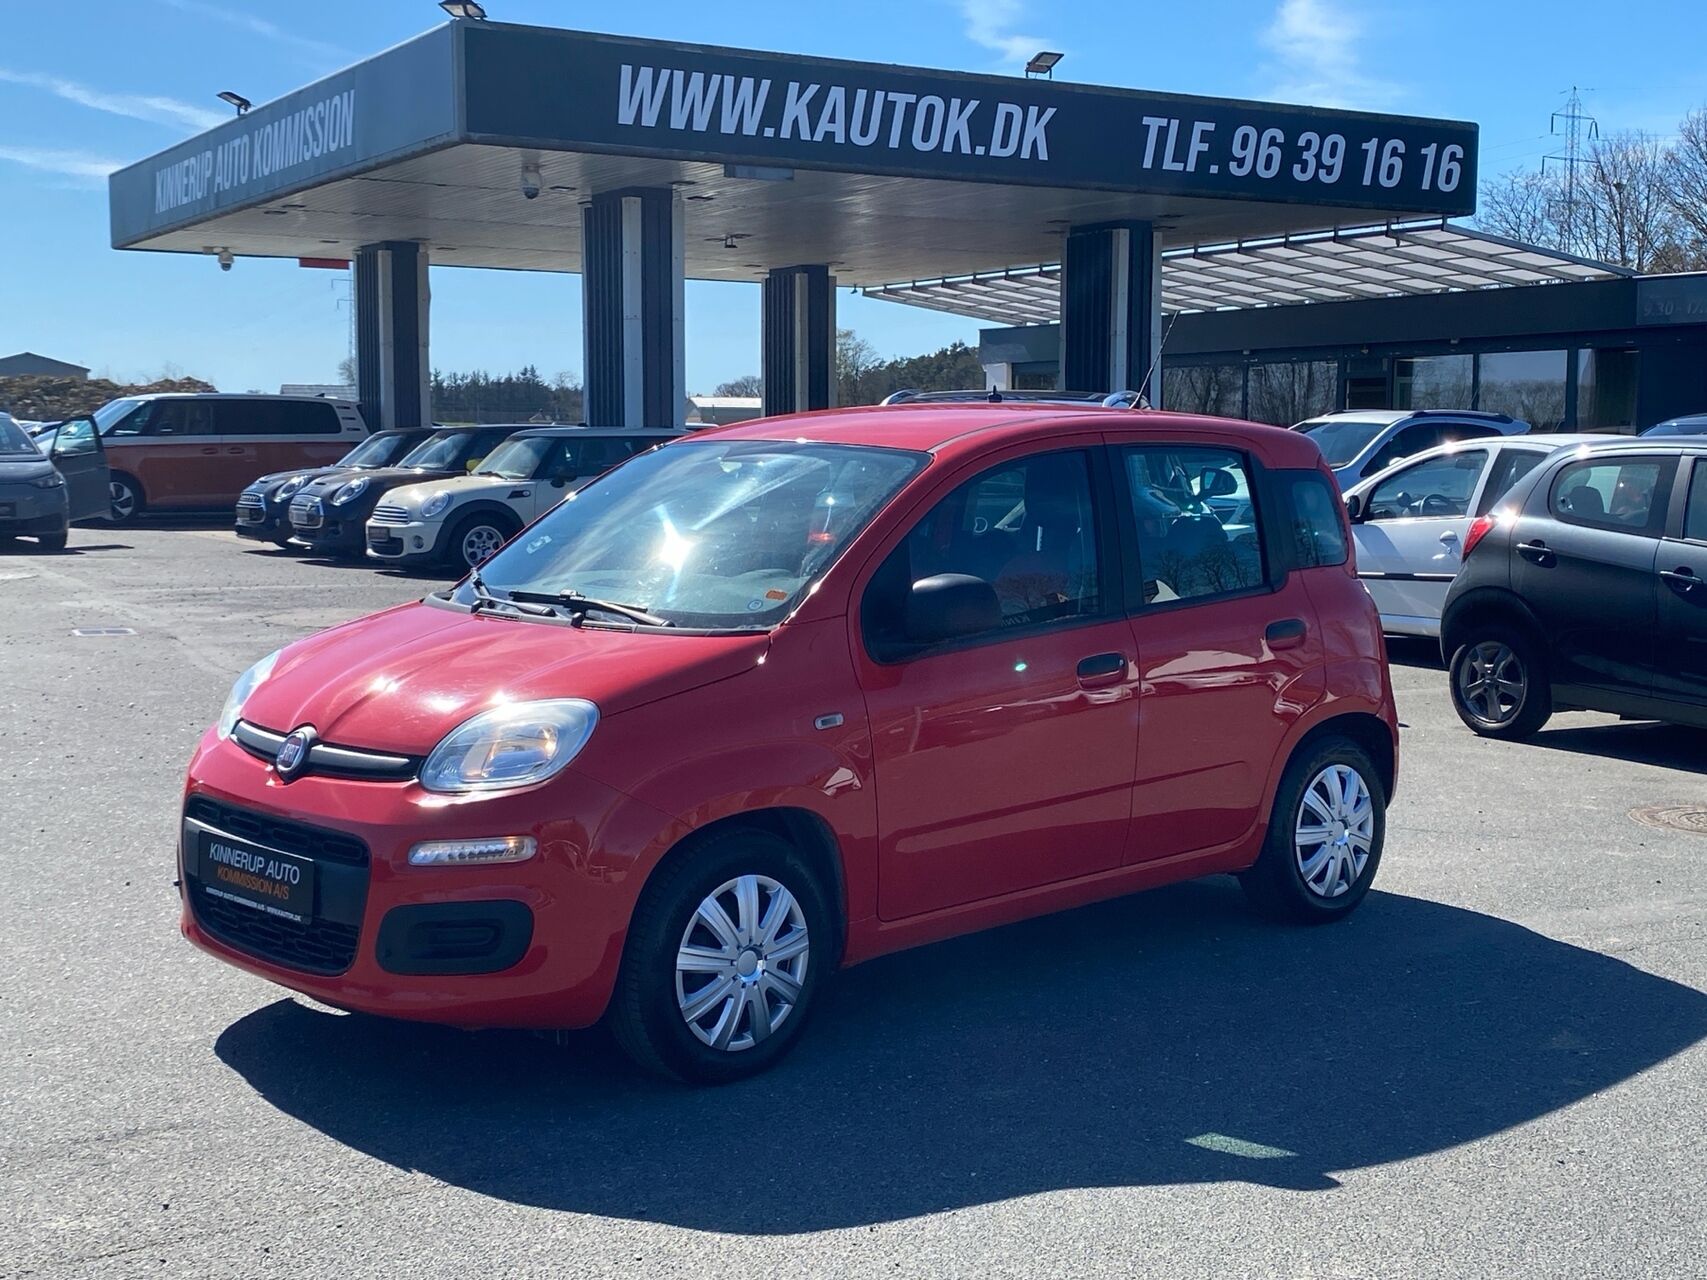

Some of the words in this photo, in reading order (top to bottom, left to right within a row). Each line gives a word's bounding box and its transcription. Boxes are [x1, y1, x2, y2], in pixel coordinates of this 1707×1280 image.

[617, 64, 1058, 161] WWW.KAUTOK.DK
[155, 150, 213, 215] KINNERUP
[214, 134, 250, 193] AUTO
[252, 89, 355, 180] KOMMISSION
[1142, 116, 1219, 174] TLF.
[1229, 125, 1285, 179] 96
[1292, 131, 1346, 184] 39
[1361, 137, 1405, 188] 16
[1421, 142, 1464, 192] 16
[209, 842, 265, 873] KINNERUP
[265, 860, 300, 884] AUTO
[217, 865, 273, 894] KOMMISSION
[273, 883, 290, 900] A/S
